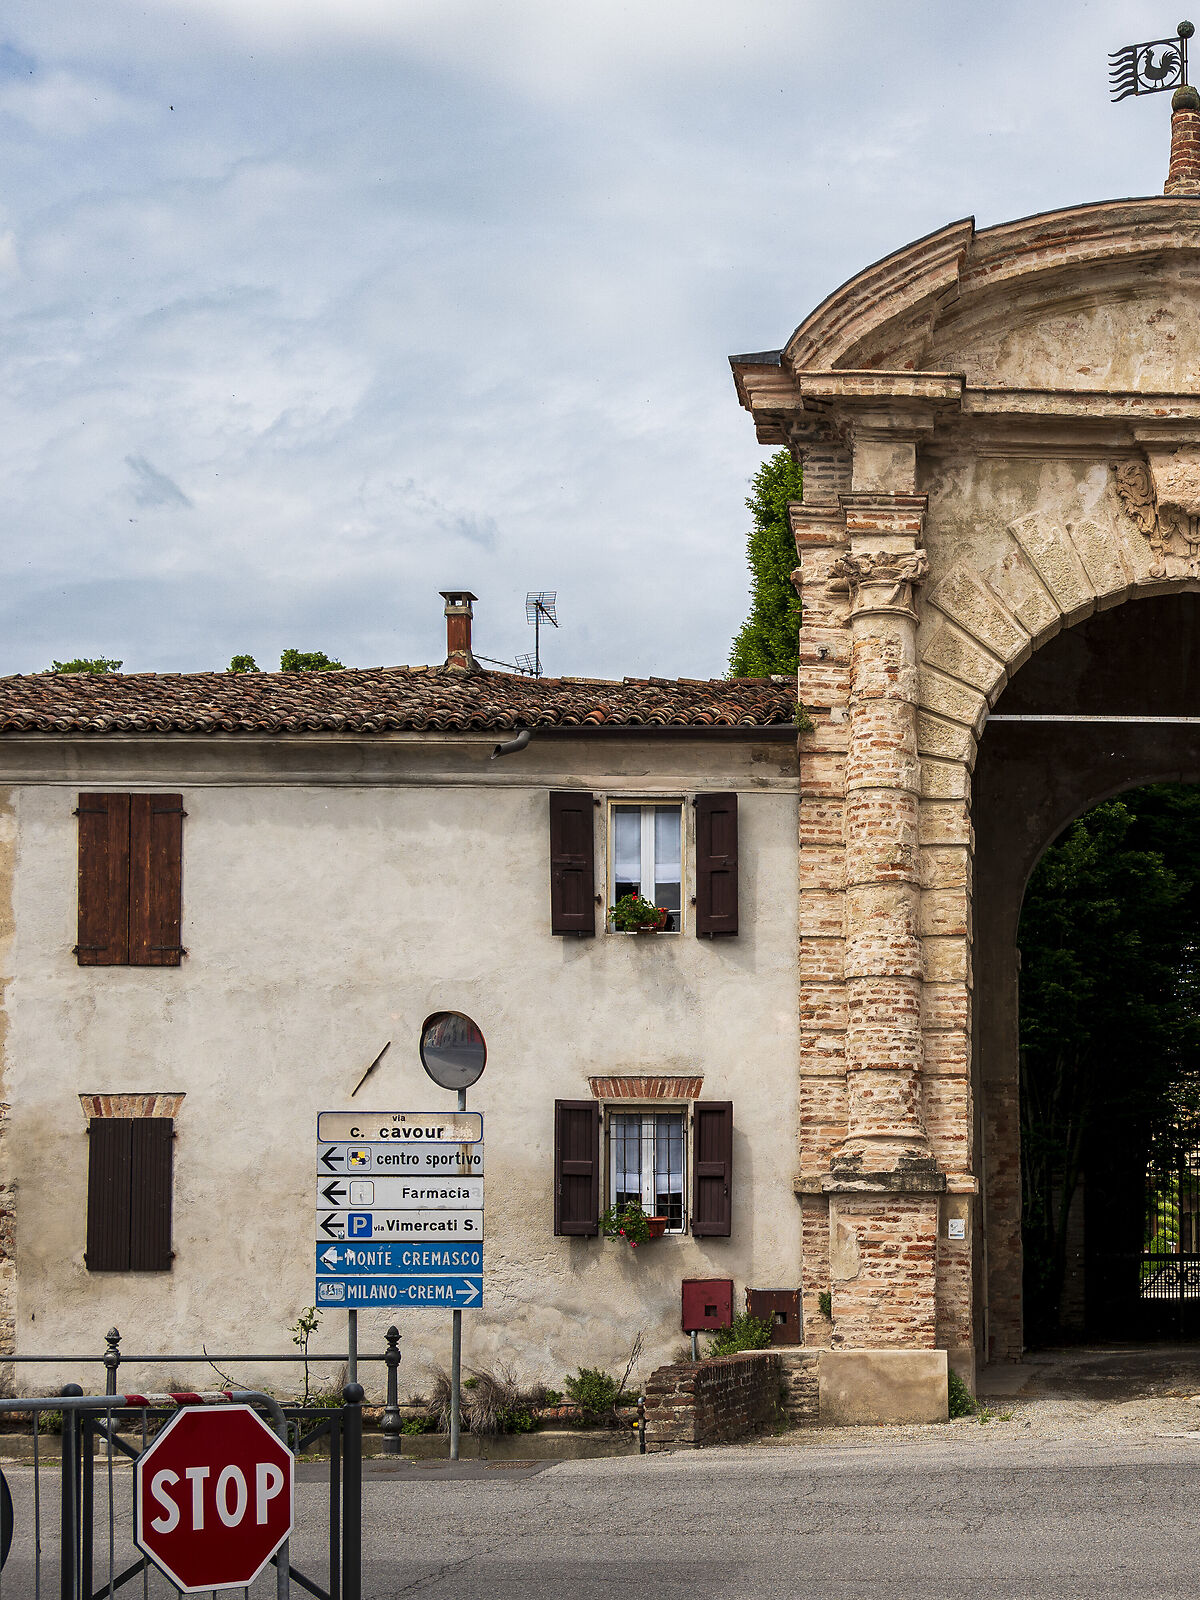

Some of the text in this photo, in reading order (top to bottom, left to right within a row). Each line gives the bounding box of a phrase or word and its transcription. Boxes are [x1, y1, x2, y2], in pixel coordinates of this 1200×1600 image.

[392, 1114, 406, 1122] via
[350, 1127, 444, 1138] c. cavour
[376, 1151, 481, 1168] centro sportivo
[402, 1187, 470, 1198] Farmacia
[353, 1216, 368, 1235] P
[386, 1219, 458, 1231] Vimercati
[463, 1219, 479, 1231] S.
[346, 1251, 480, 1266] MONTE CREMASCO
[150, 1462, 285, 1534] STOP
